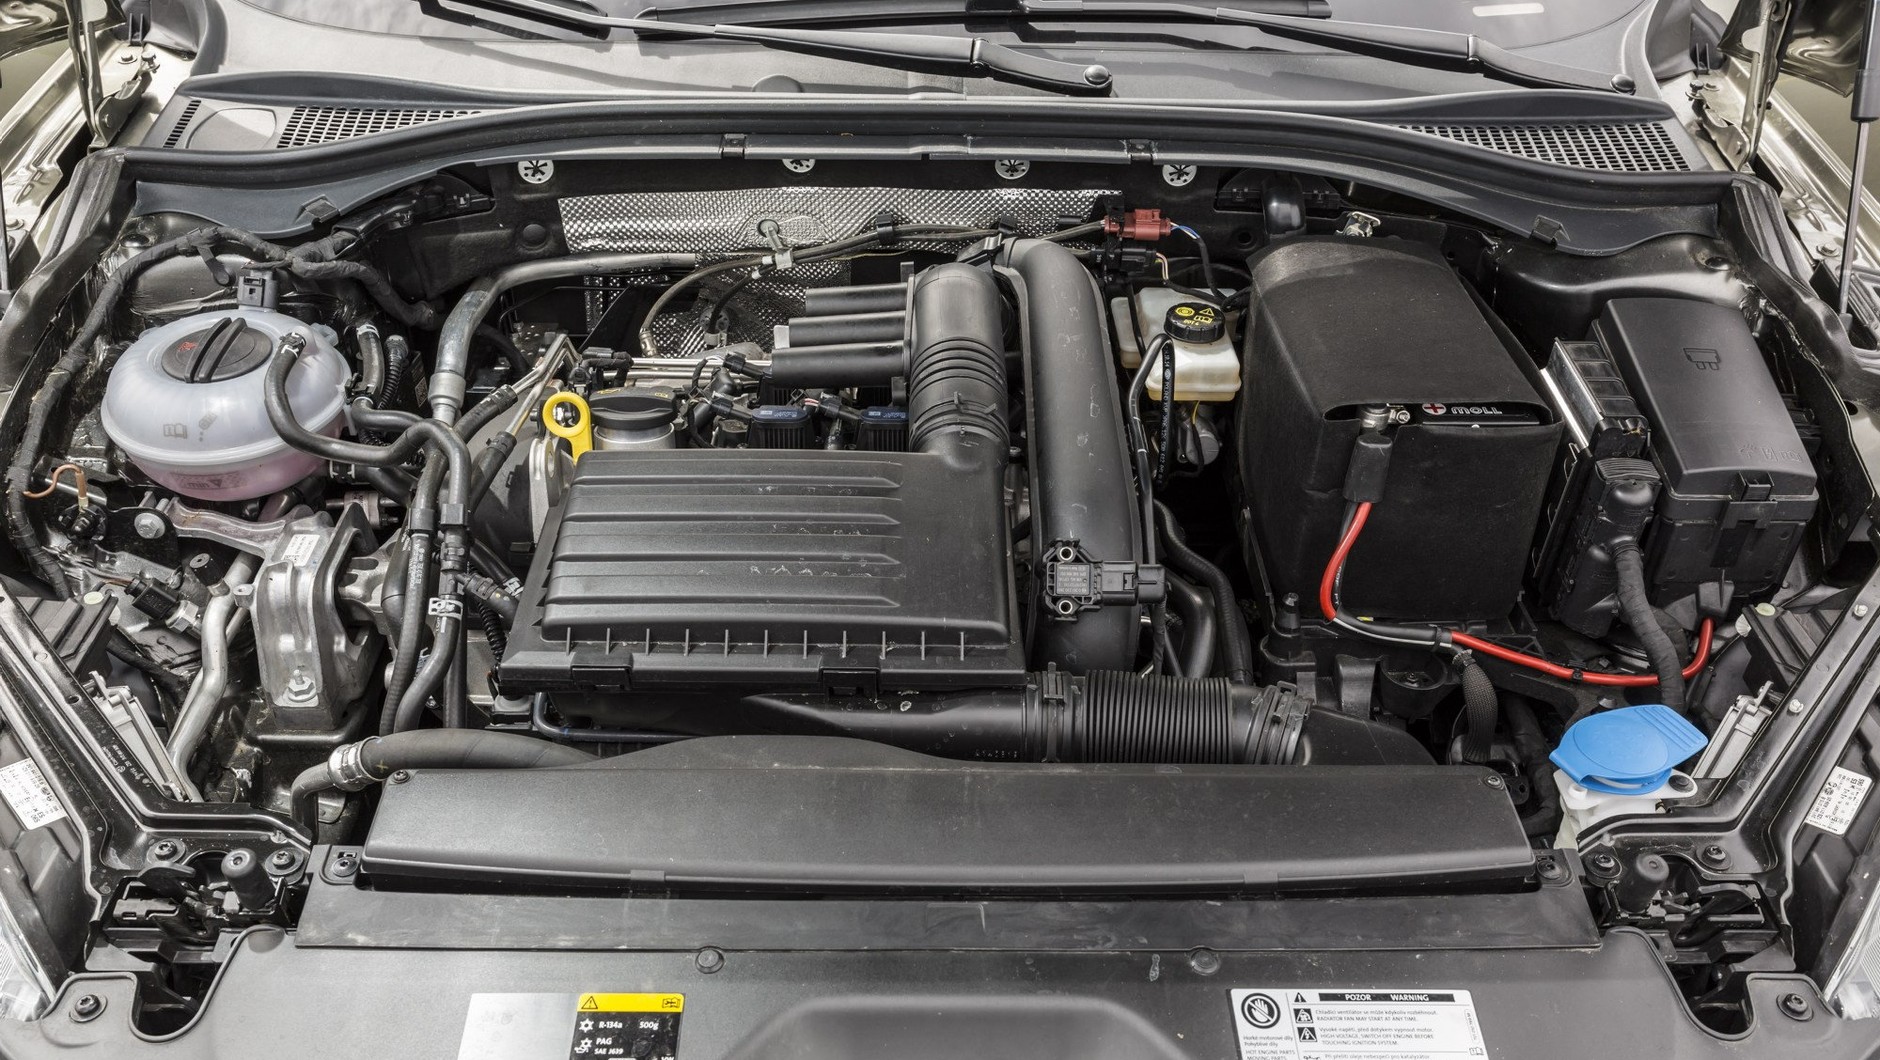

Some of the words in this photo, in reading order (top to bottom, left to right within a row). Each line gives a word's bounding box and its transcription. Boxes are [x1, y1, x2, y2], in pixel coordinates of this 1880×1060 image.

[1344, 993, 1372, 1001] POZOR
[1389, 993, 1430, 1001] WARNING
[598, 1020, 623, 1029] R-134a
[639, 1021, 659, 1030] 500g
[595, 1037, 613, 1045] PAG
